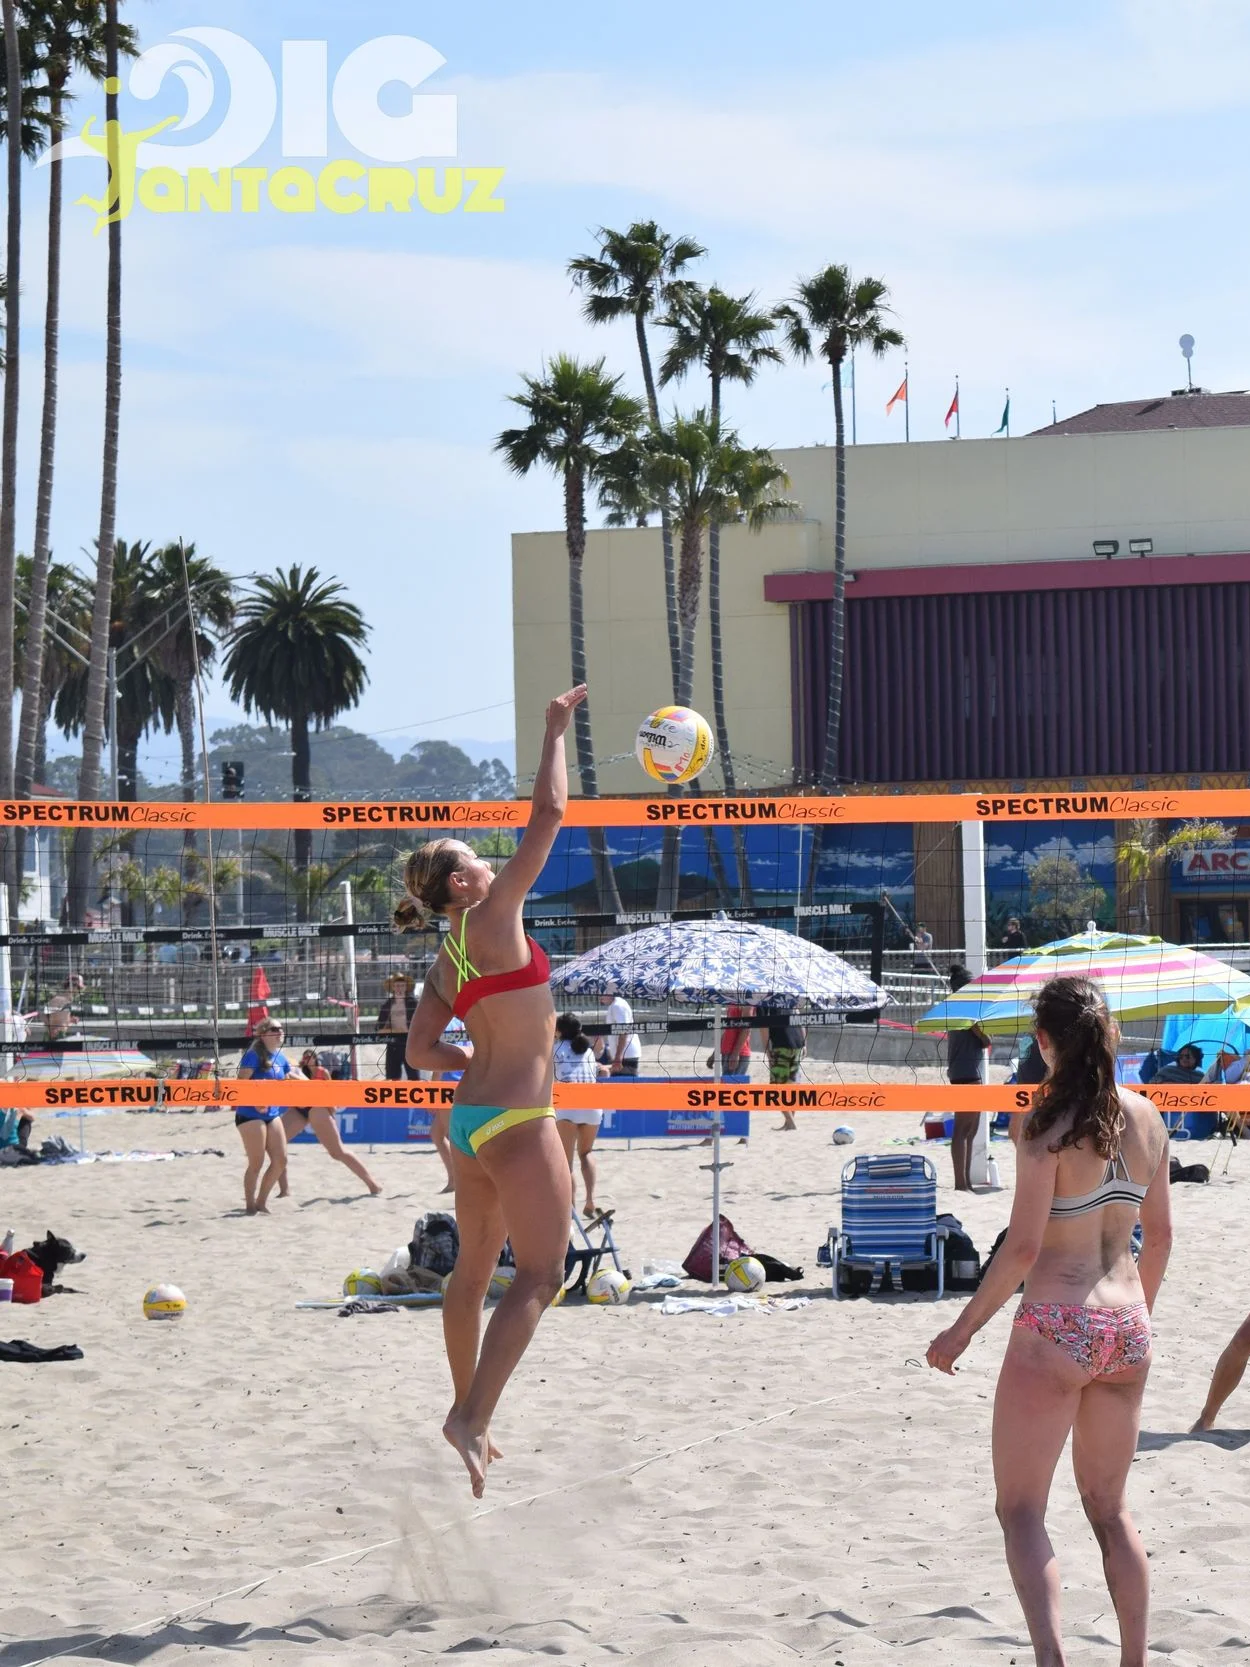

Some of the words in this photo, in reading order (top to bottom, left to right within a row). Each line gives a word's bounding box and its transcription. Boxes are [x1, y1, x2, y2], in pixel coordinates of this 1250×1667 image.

[3, 805, 129, 822] SPECTRUM
[130, 806, 197, 823] Classic
[323, 805, 451, 823] SPECTRUM
[452, 806, 519, 822] Classic
[646, 803, 776, 820] SPECTRUM
[777, 802, 845, 818] Classic
[976, 797, 1108, 816] SPECTRUM
[1110, 796, 1179, 812] Classic
[616, 913, 650, 924] MUSCLE
[794, 905, 828, 917] MUSCLE
[829, 904, 853, 914] MILK
[88, 932, 122, 943] MUSCLE
[122, 931, 145, 942] MILK
[263, 927, 297, 938] MUSCLE
[298, 926, 320, 937] MILK
[790, 1014, 824, 1026] MUSCLE
[824, 1013, 847, 1025] MILK
[46, 1086, 171, 1104] SPECTRUM
[172, 1086, 238, 1102] Classic
[687, 1090, 817, 1107] SPECTRUM
[818, 1090, 886, 1107] Classic
[1150, 1091, 1218, 1107] Classic
